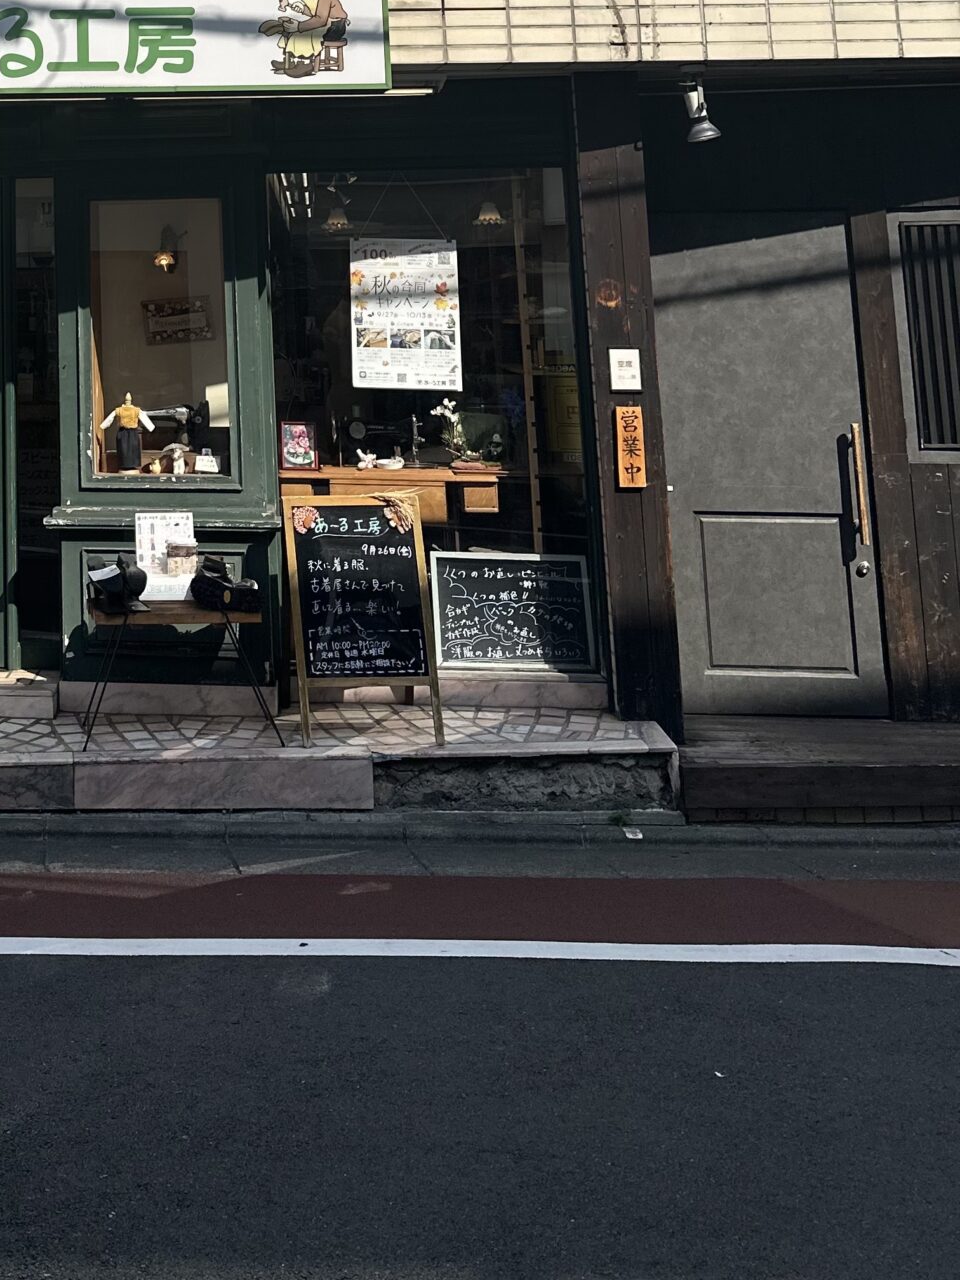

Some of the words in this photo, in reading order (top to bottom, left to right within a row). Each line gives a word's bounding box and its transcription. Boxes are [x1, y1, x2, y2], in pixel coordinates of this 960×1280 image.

[370, 275, 427, 295] 秋の合同
[375, 296, 430, 309] キャンペーン
[620, 410, 642, 484] 営業中
[361, 648, 385, 657] 水曜日
